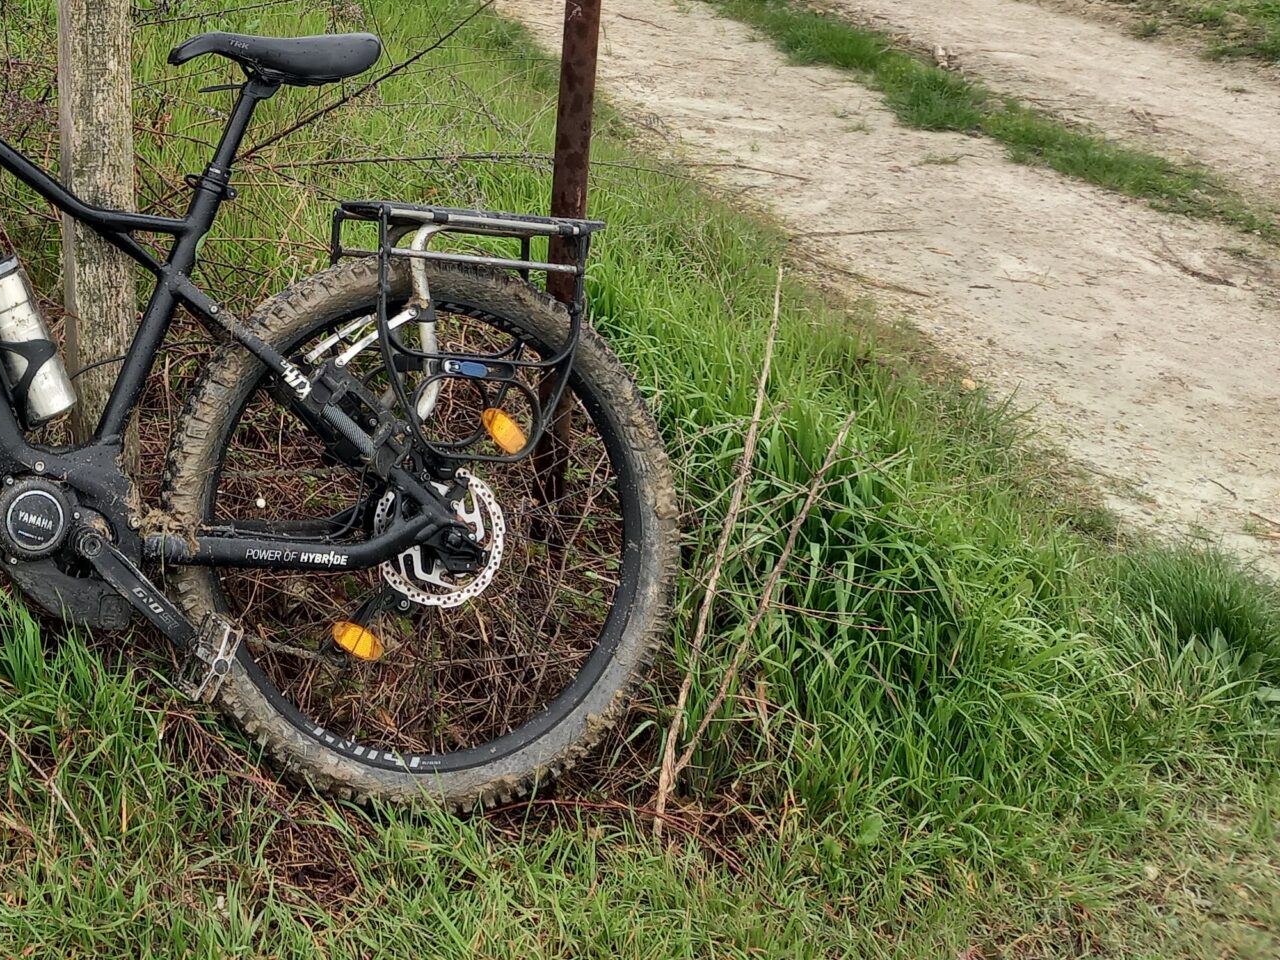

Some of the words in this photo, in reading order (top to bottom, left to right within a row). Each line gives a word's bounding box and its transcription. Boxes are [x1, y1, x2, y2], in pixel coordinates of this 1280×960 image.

[228, 39, 250, 51] TRK
[18, 510, 53, 531] YAMAHA
[245, 548, 282, 561] POWER
[283, 550, 299, 562] OF
